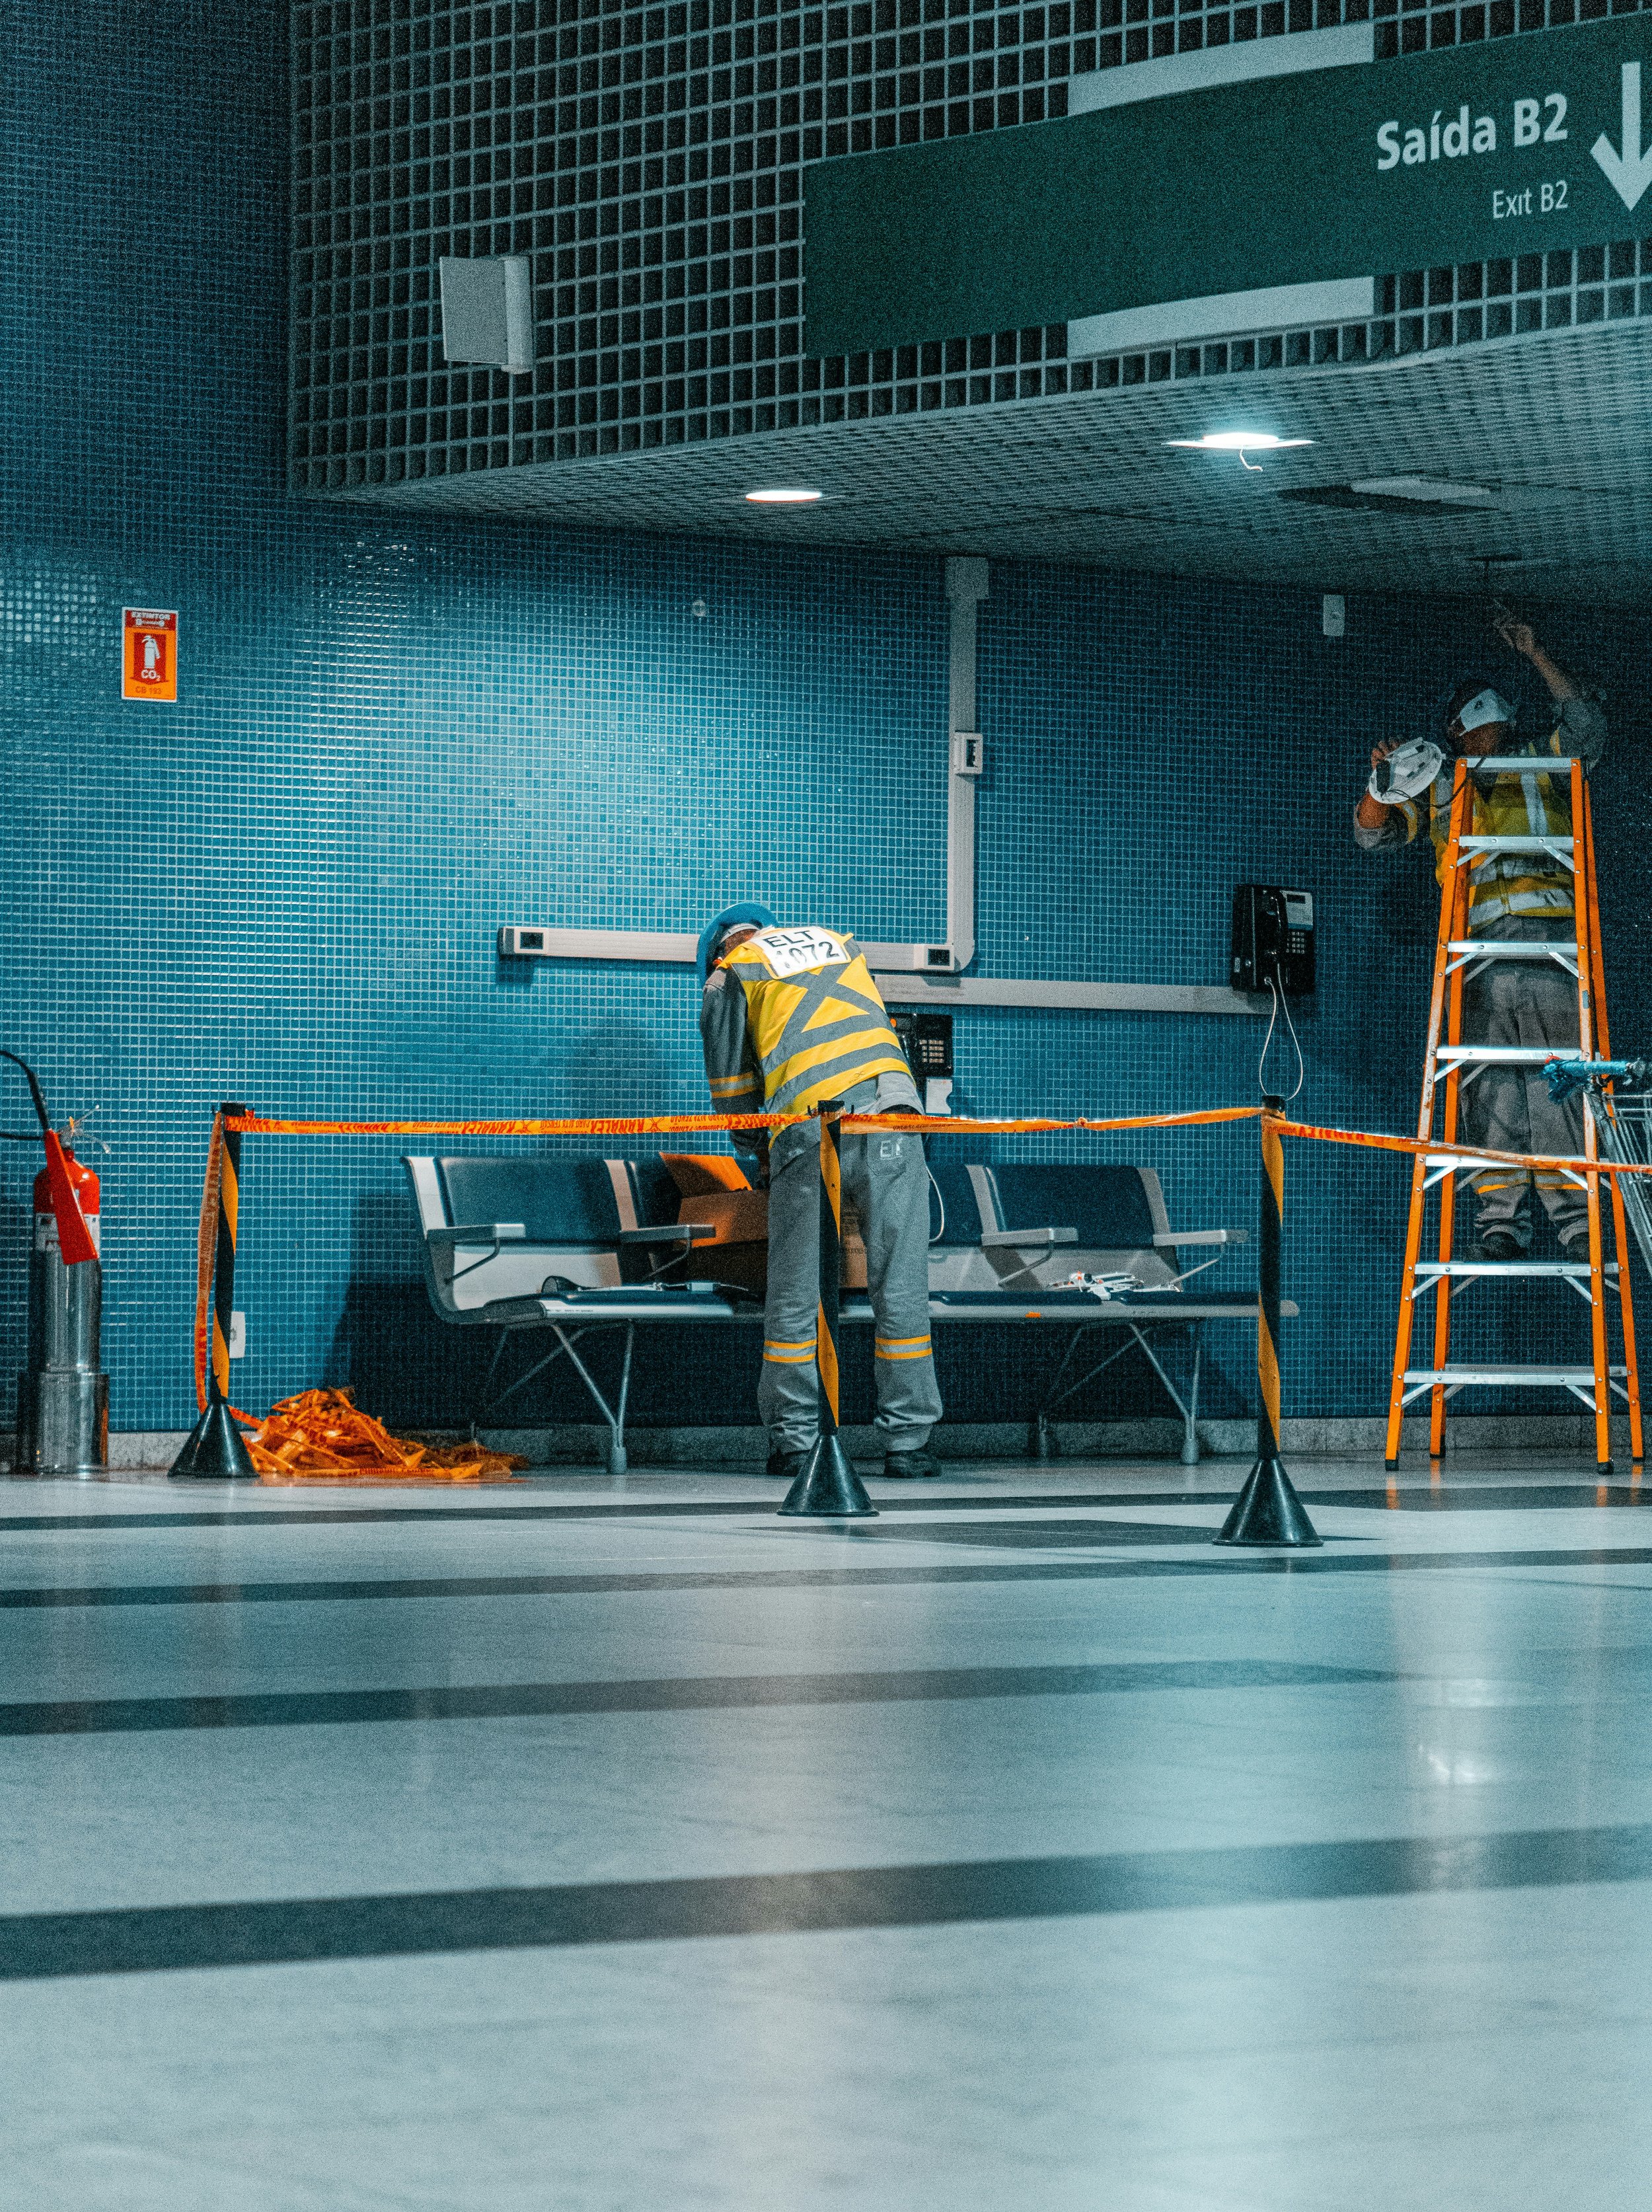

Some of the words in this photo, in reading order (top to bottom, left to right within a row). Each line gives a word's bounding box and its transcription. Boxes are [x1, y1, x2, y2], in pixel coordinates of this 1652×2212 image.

[1377, 105, 1496, 170] Saída
[1514, 93, 1568, 148] B2
[1493, 188, 1532, 219] Exit
[1541, 180, 1568, 213] B2
[763, 930, 814, 948] ELT
